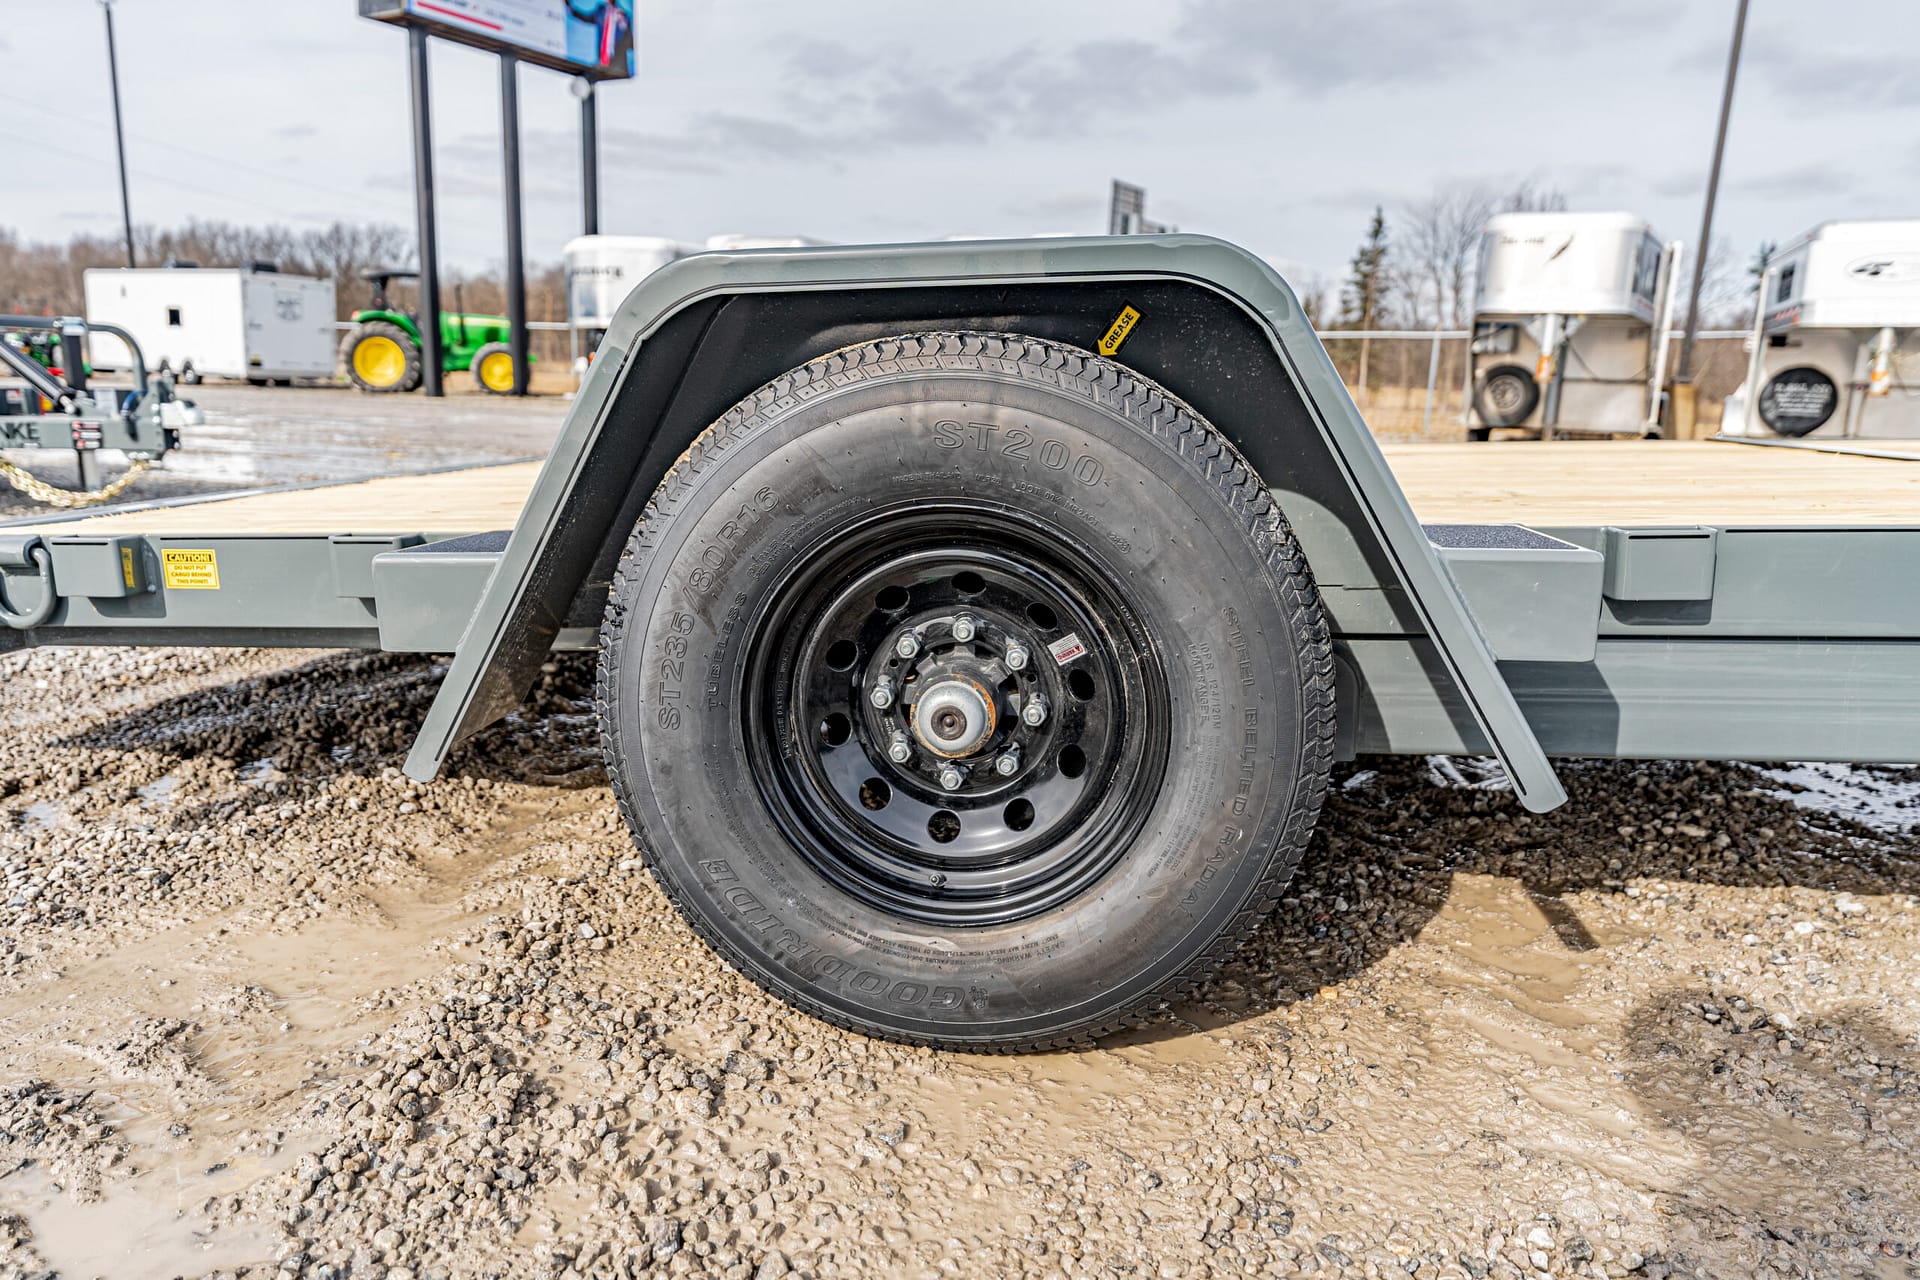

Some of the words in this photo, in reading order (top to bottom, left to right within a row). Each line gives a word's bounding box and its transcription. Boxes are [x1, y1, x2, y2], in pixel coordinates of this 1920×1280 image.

[1105, 313, 1134, 349] GREASE
[934, 419, 1105, 487] ST200
[707, 590, 748, 712] TUBELESS
[699, 859, 966, 1011] GOODRIDE
